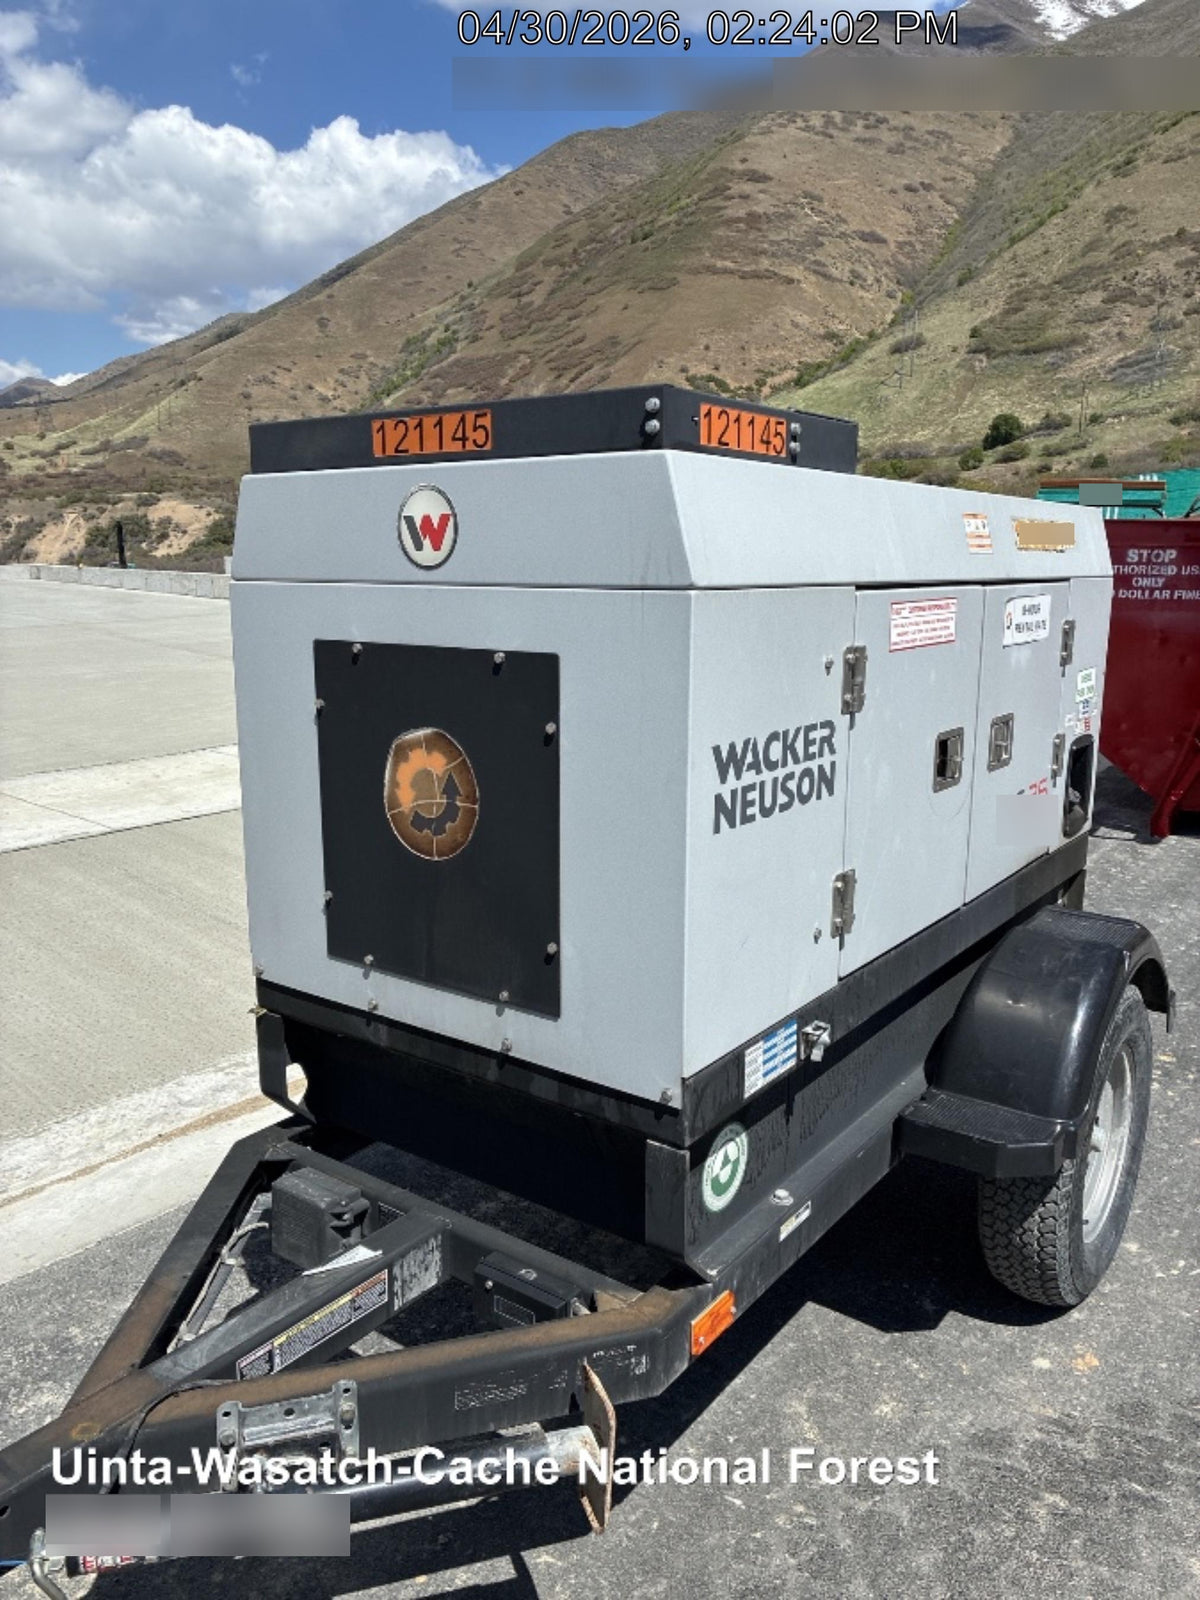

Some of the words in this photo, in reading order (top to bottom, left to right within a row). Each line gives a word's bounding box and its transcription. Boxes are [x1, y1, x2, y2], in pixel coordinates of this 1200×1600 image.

[375, 413, 491, 455] 121145
[702, 406, 786, 455] 121145
[1126, 549, 1177, 563] STOP
[1182, 565, 1200, 575] US
[1118, 589, 1171, 600] DOLLAR
[1132, 577, 1165, 587] ONLY
[712, 720, 836, 785] WACKER
[713, 761, 836, 835] NEUSON
